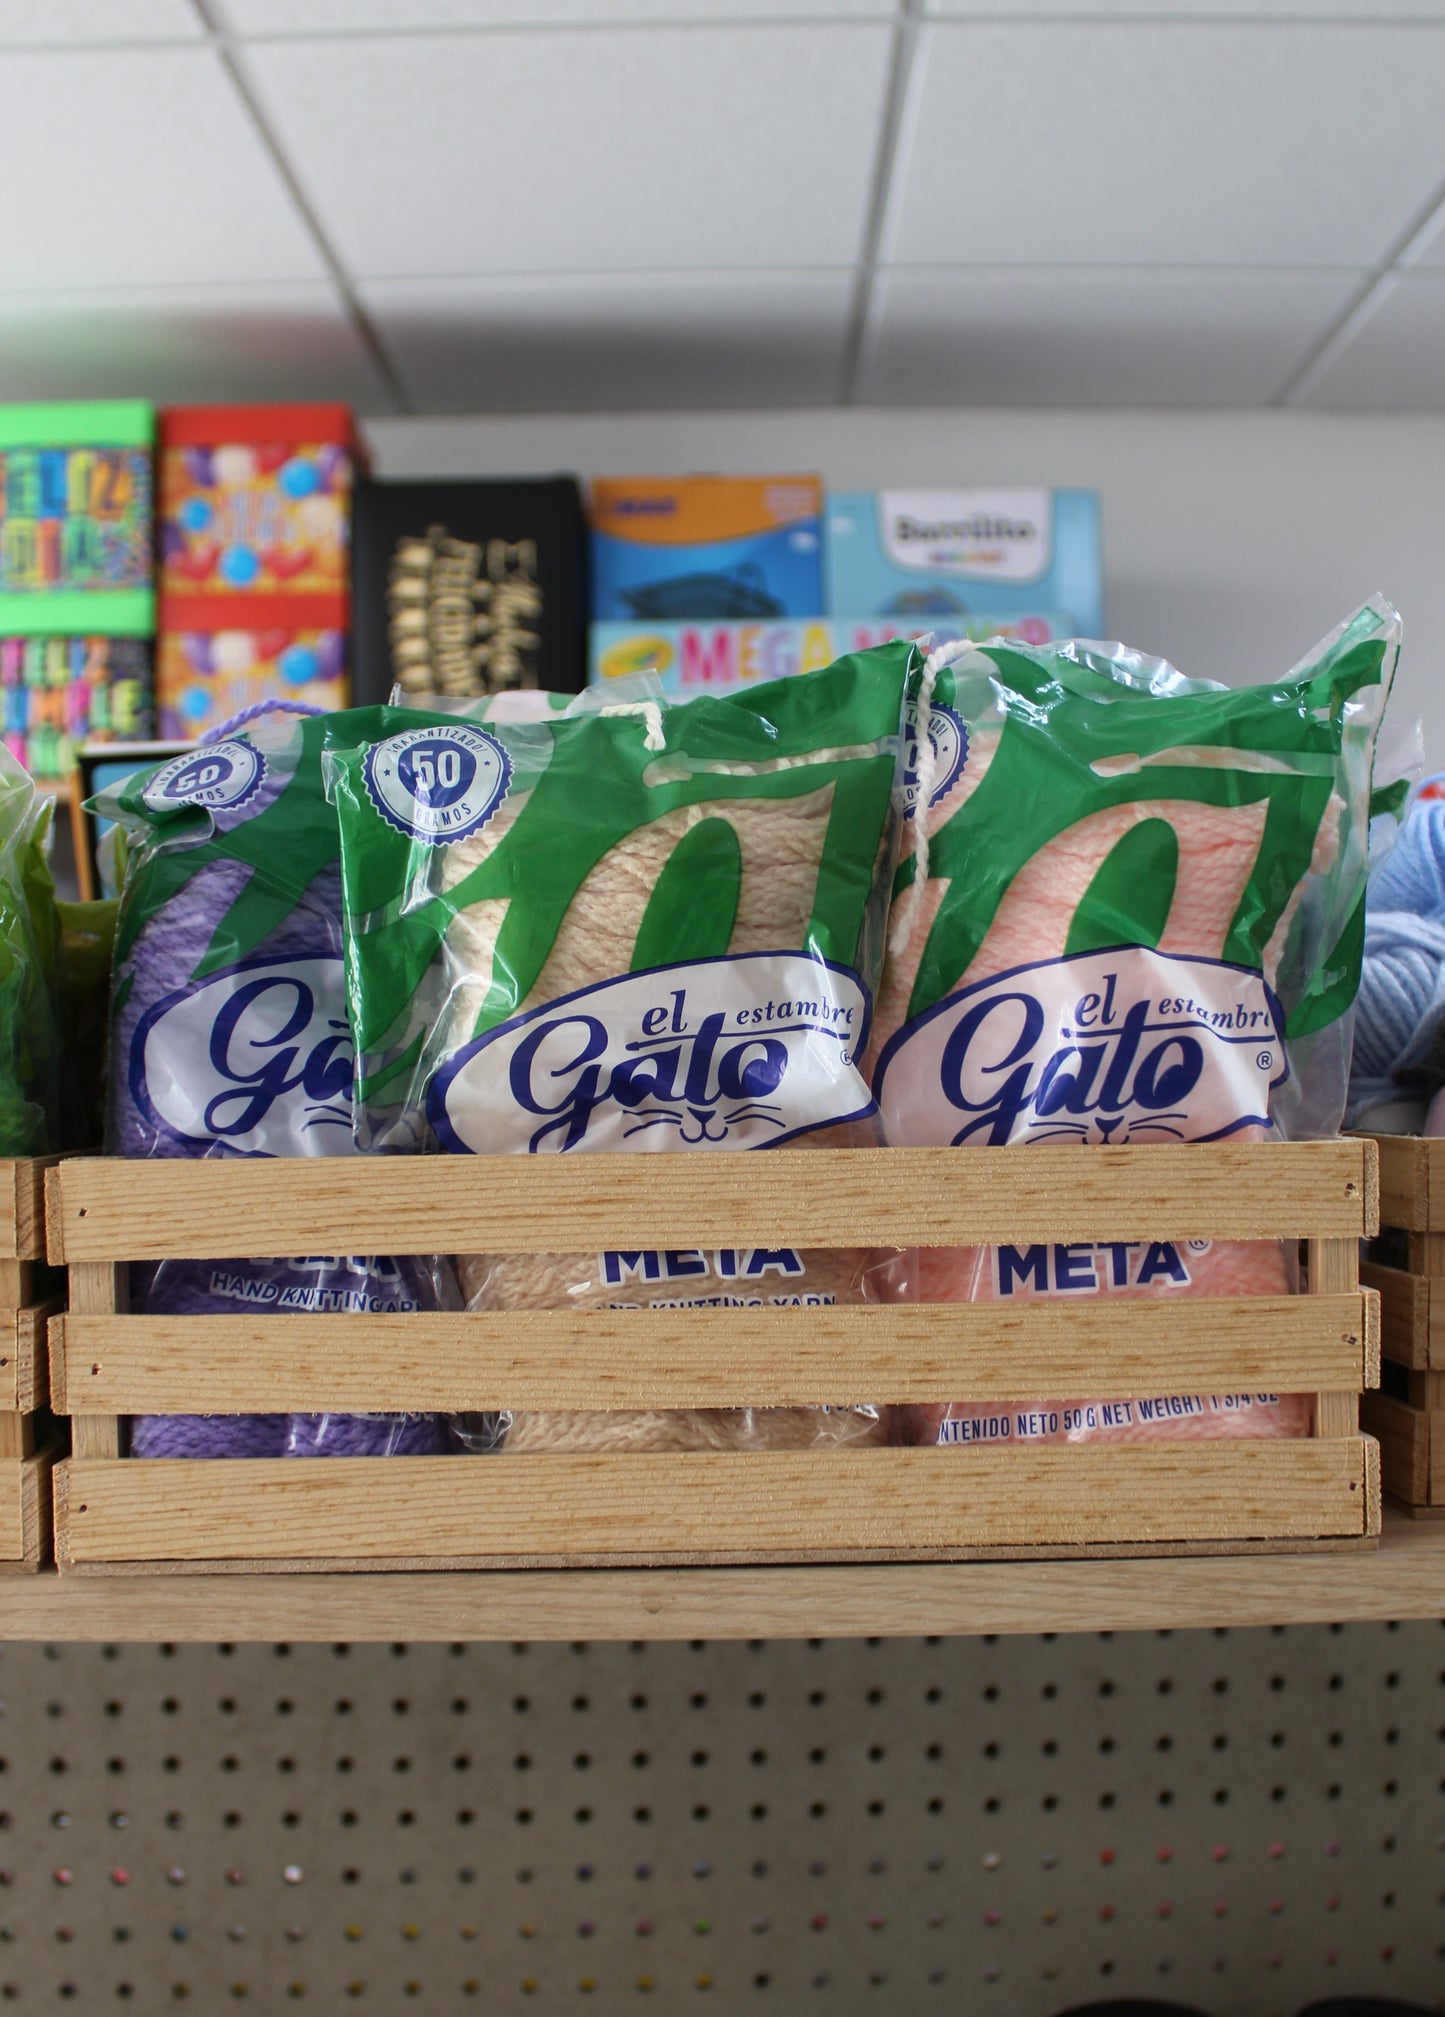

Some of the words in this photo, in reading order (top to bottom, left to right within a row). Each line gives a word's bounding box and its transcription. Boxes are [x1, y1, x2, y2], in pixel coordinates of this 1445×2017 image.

[176, 764, 220, 793] 50
[411, 749, 461, 793] 50
[641, 989, 688, 1036] el
[1075, 973, 1118, 1027] el
[508, 1012, 790, 1153] Gato
[940, 991, 1205, 1146] Gato
[211, 1271, 278, 1300] HAND
[1000, 1241, 1188, 1295] META
[937, 1416, 1010, 1443] NTENIDO
[1018, 1411, 1058, 1436] NETO
[1063, 1409, 1082, 1431] 50
[1086, 1408, 1096, 1428] G
[1103, 1402, 1132, 1427] NET
